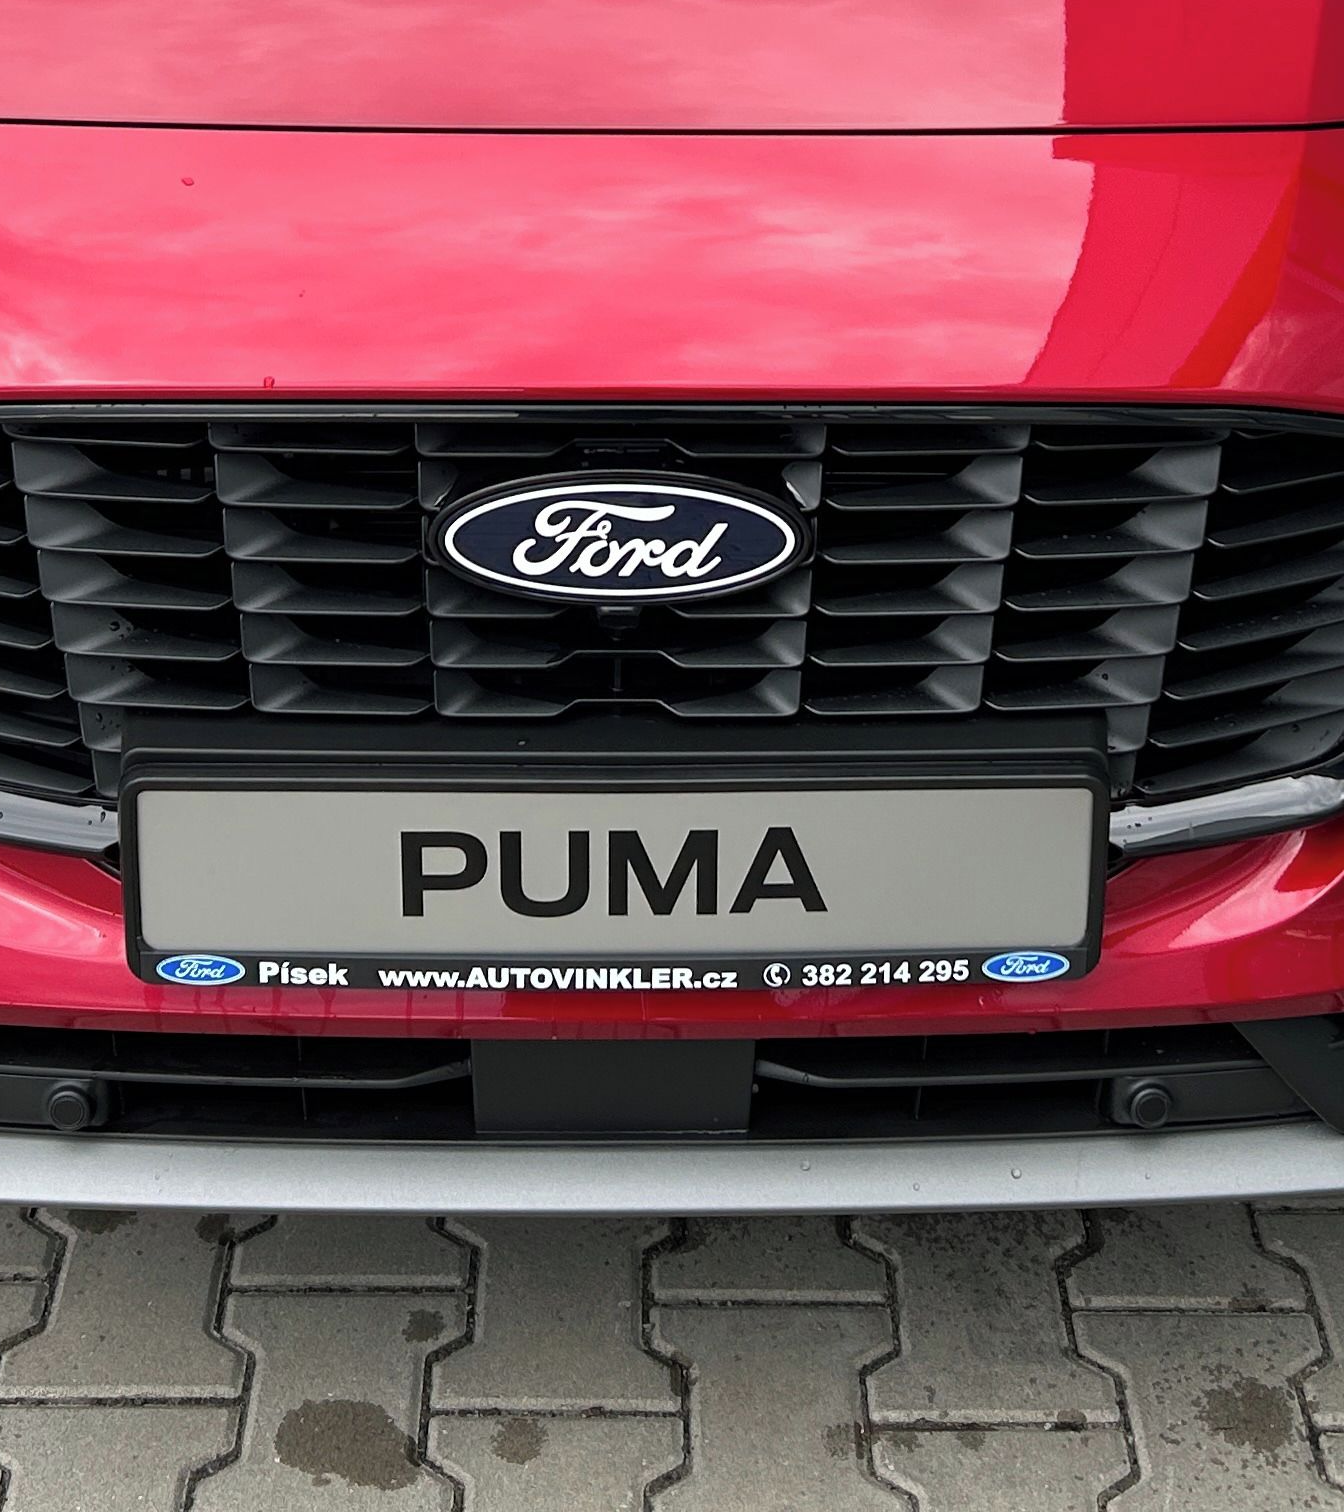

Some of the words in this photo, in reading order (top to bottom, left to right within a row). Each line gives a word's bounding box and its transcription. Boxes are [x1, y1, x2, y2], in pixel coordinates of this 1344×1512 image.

[513, 500, 729, 577] Ford
[400, 826, 828, 918] PUMA
[174, 959, 226, 980] Ford
[258, 961, 349, 987] Písek
[378, 966, 738, 989] www.AUTOVINKLER.cz
[801, 963, 853, 986] 382
[860, 961, 912, 984] 214
[919, 960, 970, 983] 295
[1000, 955, 1051, 976] Ford
